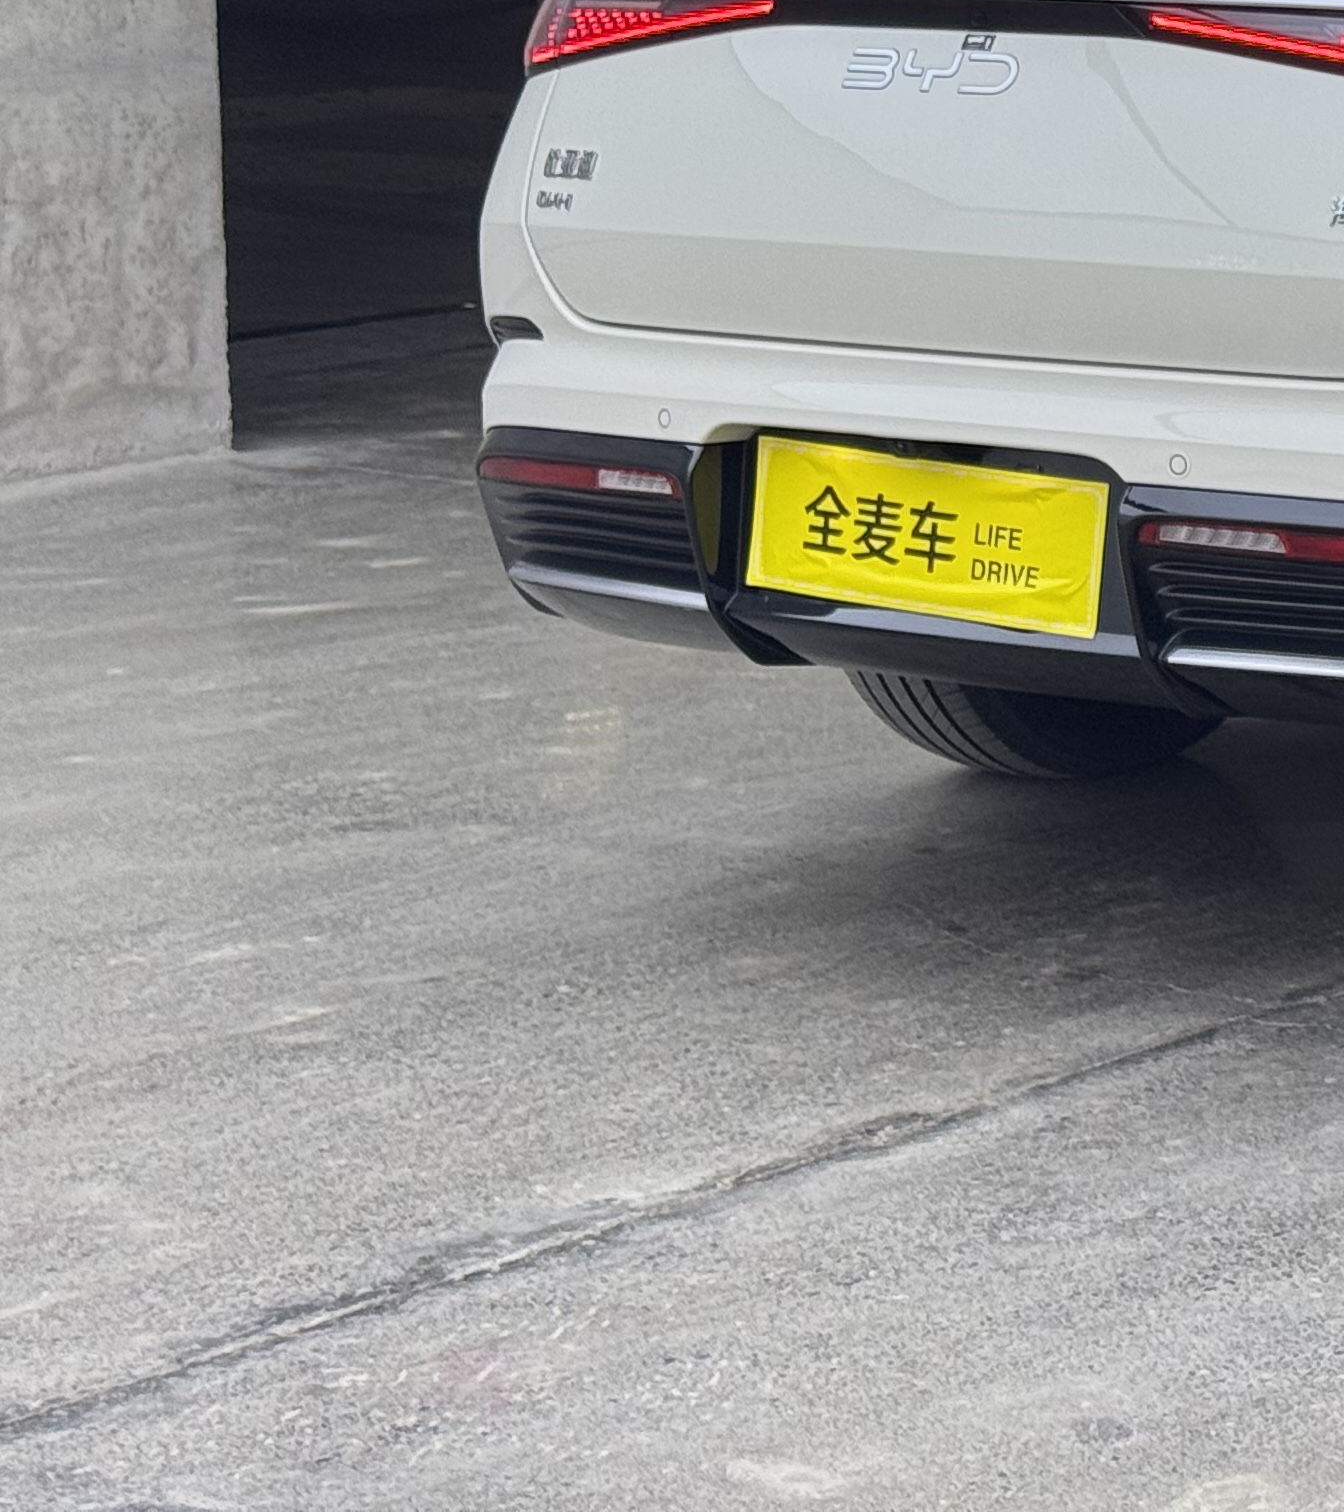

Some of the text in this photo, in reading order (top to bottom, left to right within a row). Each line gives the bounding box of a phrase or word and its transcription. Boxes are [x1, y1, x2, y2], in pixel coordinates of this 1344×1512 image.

[841, 45, 1020, 96] BYD
[802, 485, 959, 573] 全麦车
[974, 522, 1023, 552] LIFE
[970, 559, 1041, 589] DRIVE
